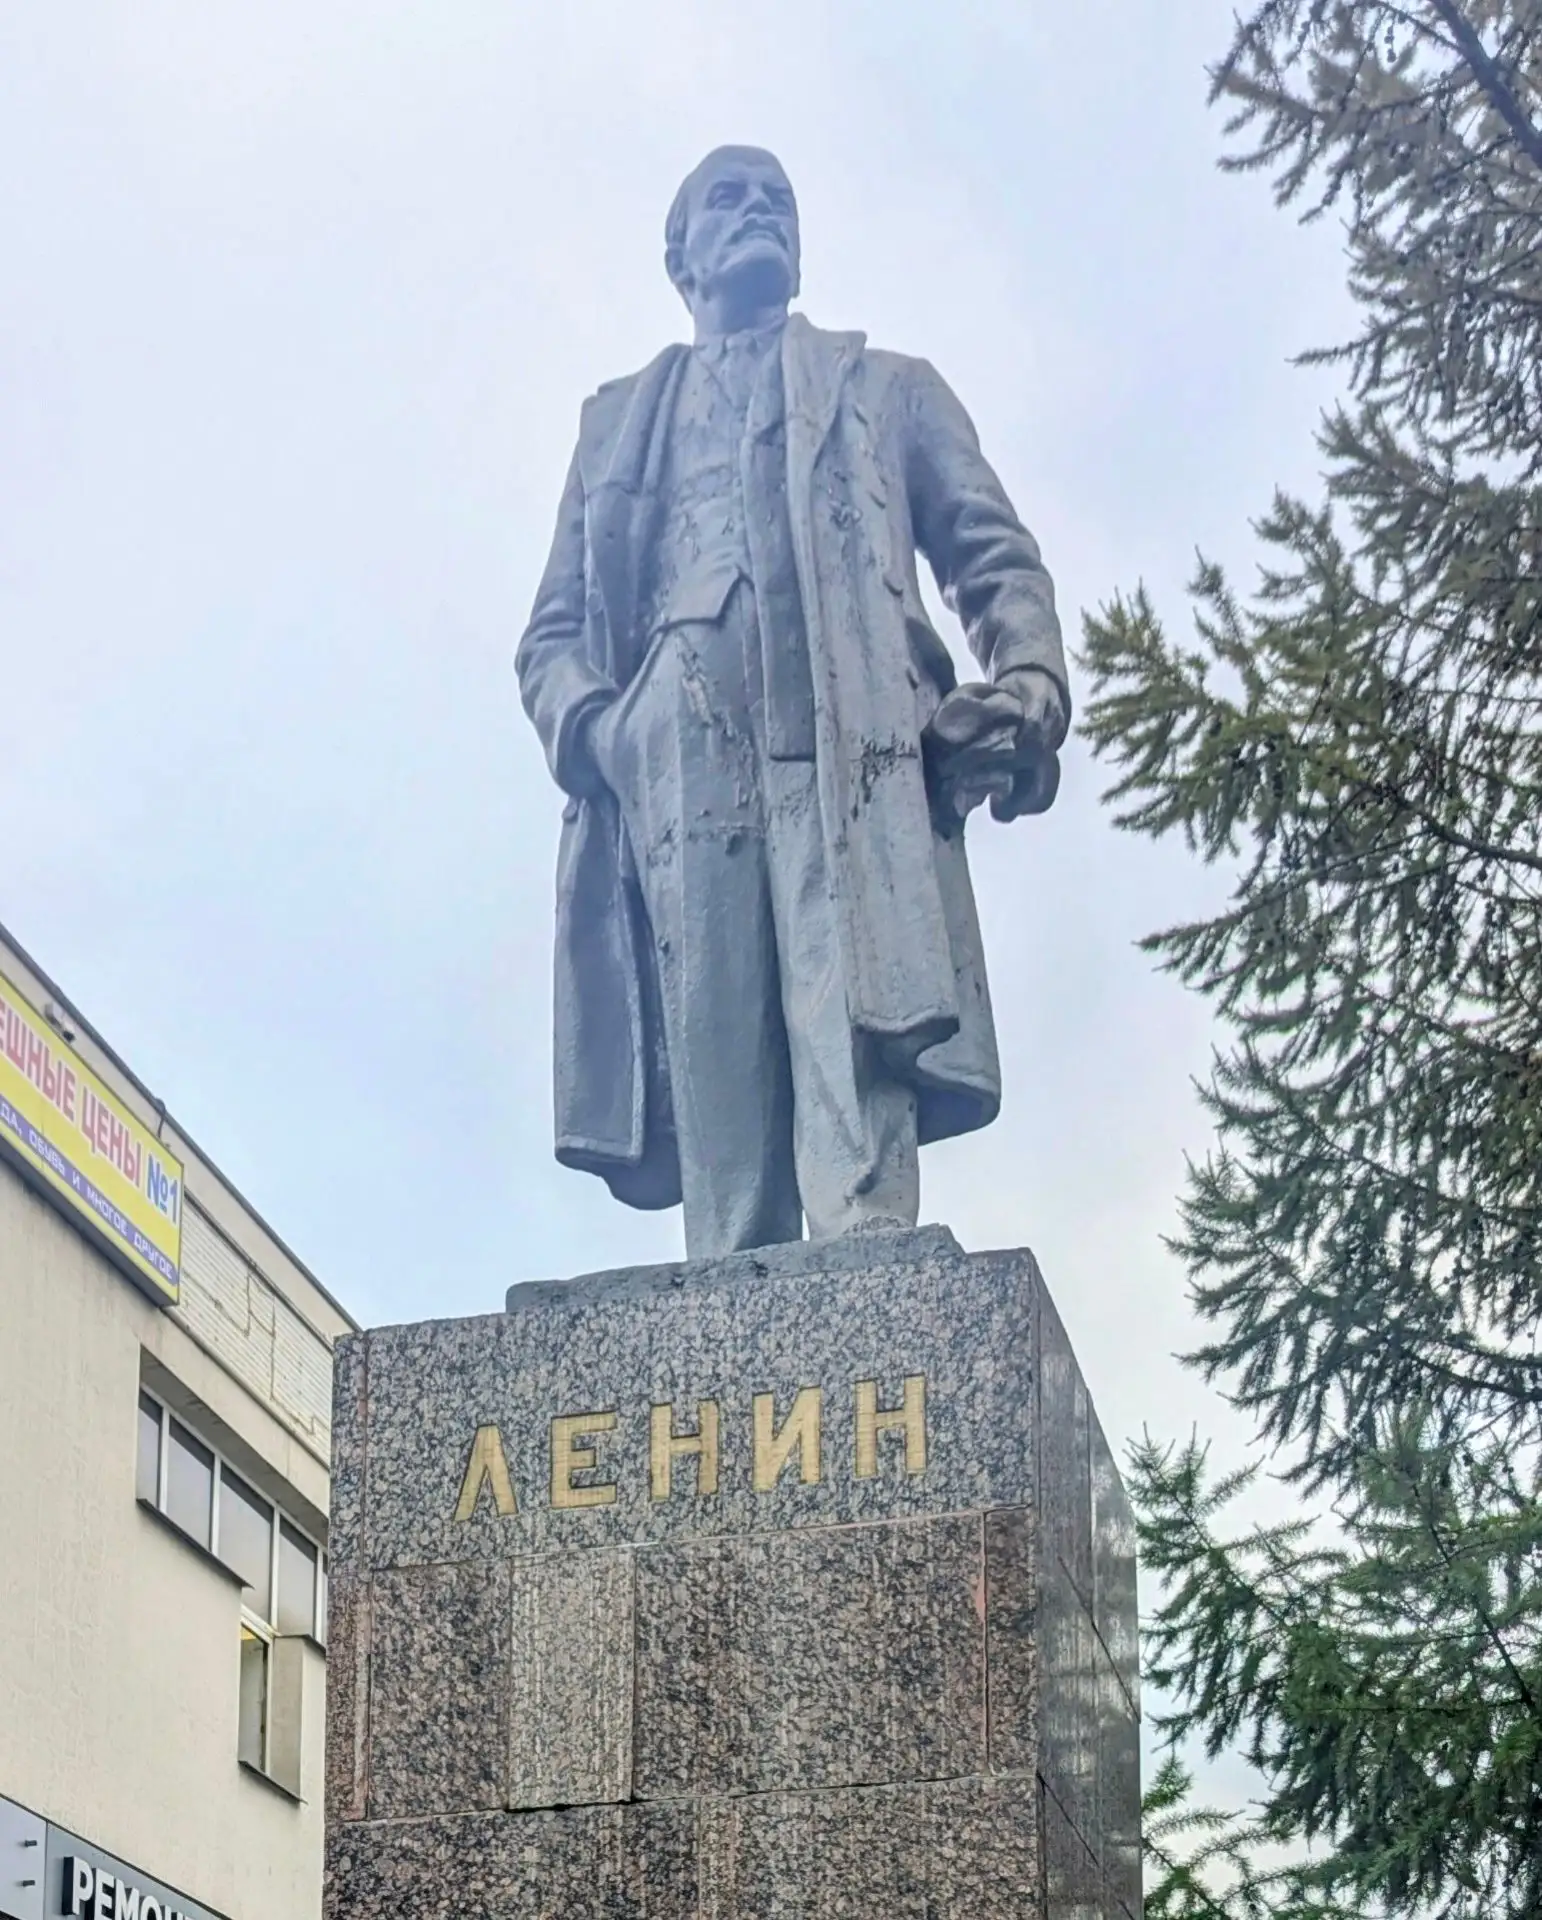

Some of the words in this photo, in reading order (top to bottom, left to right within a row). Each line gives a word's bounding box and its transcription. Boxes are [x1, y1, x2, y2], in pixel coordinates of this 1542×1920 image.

[81, 1086, 140, 1189] ЦЕНЫ
[29, 1129, 65, 1177] ОБУВЬ
[72, 1171, 80, 1191] И
[87, 1185, 128, 1237] МНОГОЕ
[134, 1232, 173, 1280] ДРУГОЕ
[454, 1372, 928, 1521] ЛЕНИН
[72, 1856, 199, 1920] РЕМ
